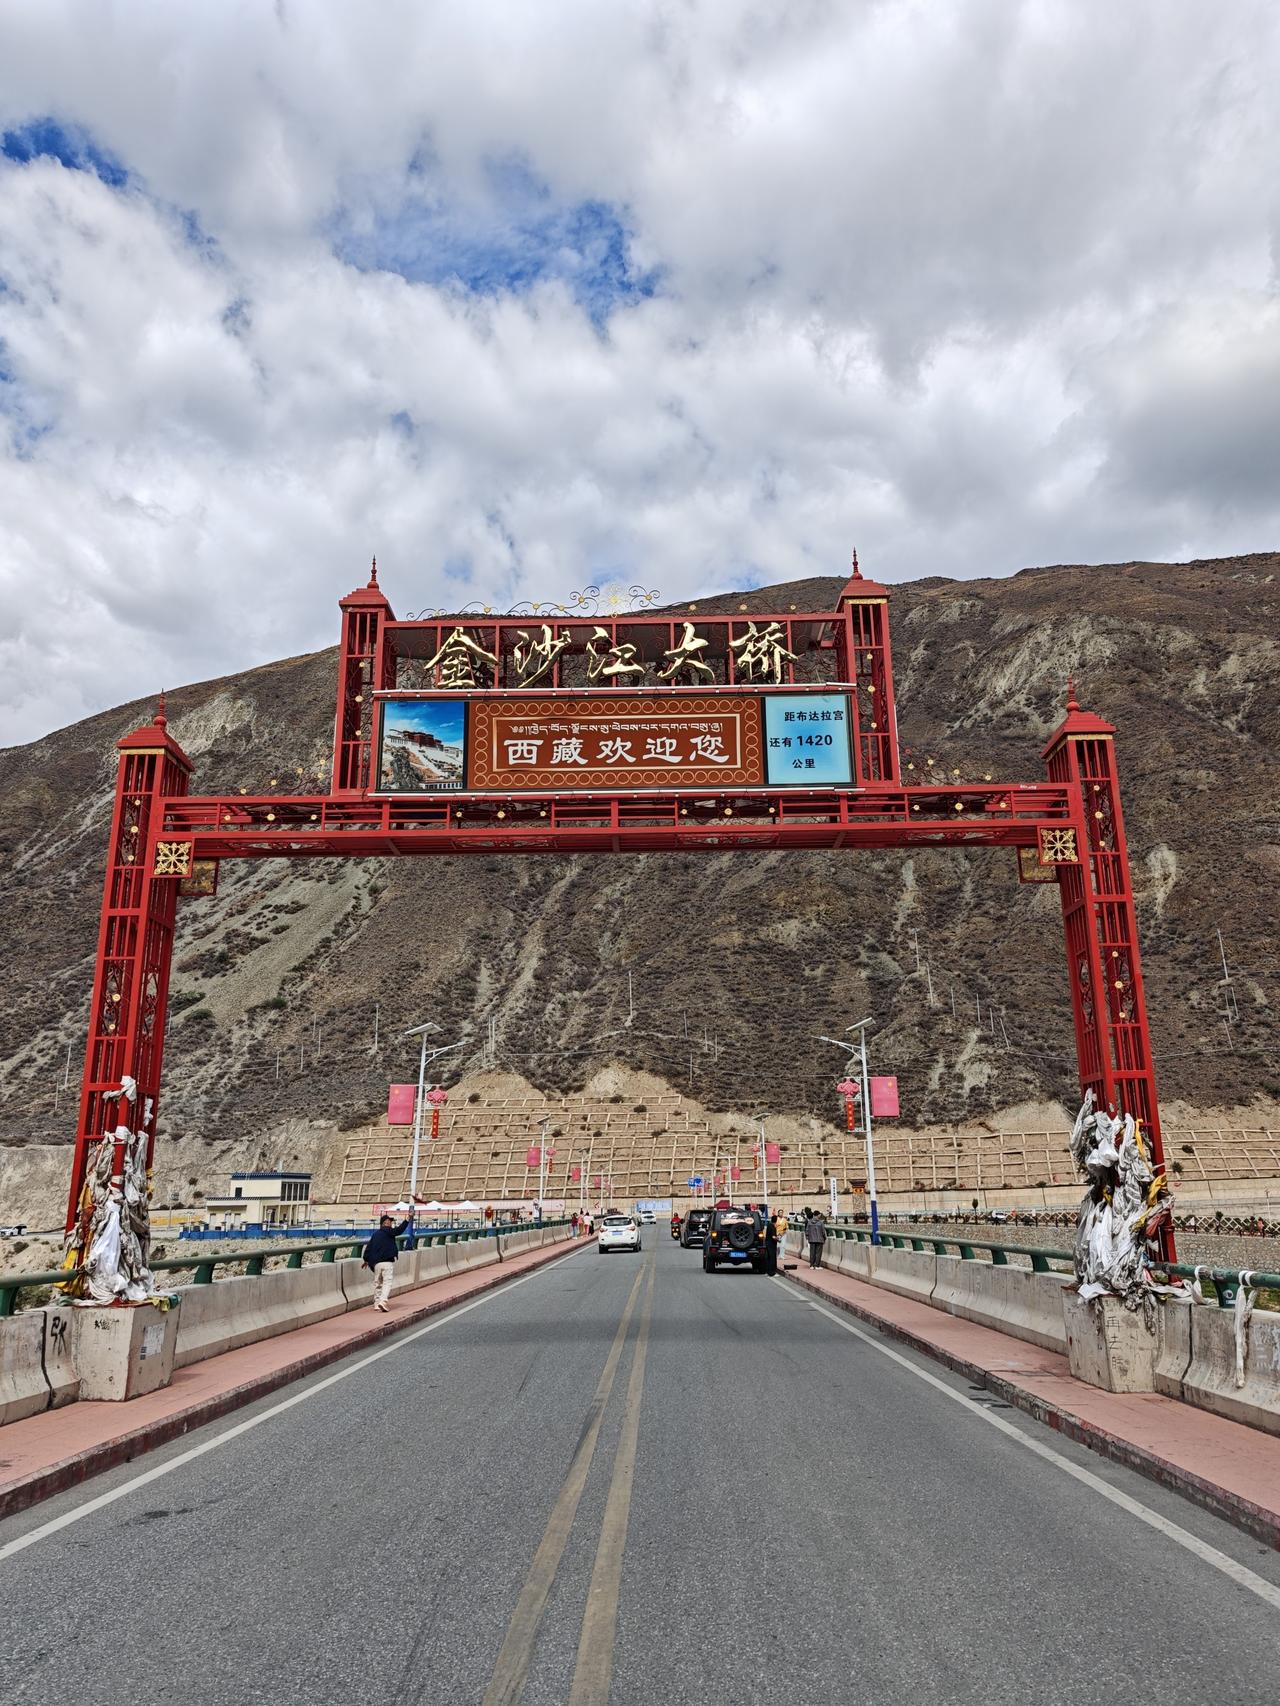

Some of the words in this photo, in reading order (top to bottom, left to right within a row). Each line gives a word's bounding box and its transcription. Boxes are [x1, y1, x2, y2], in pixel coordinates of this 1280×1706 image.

[425, 621, 801, 688] 金沙江大桥
[784, 710, 844, 722] 距布达拉宫
[769, 737, 792, 747] 还有
[797, 735, 833, 746] 1420
[503, 735, 730, 765] 西藏欢迎您
[792, 758, 816, 769] 公里
